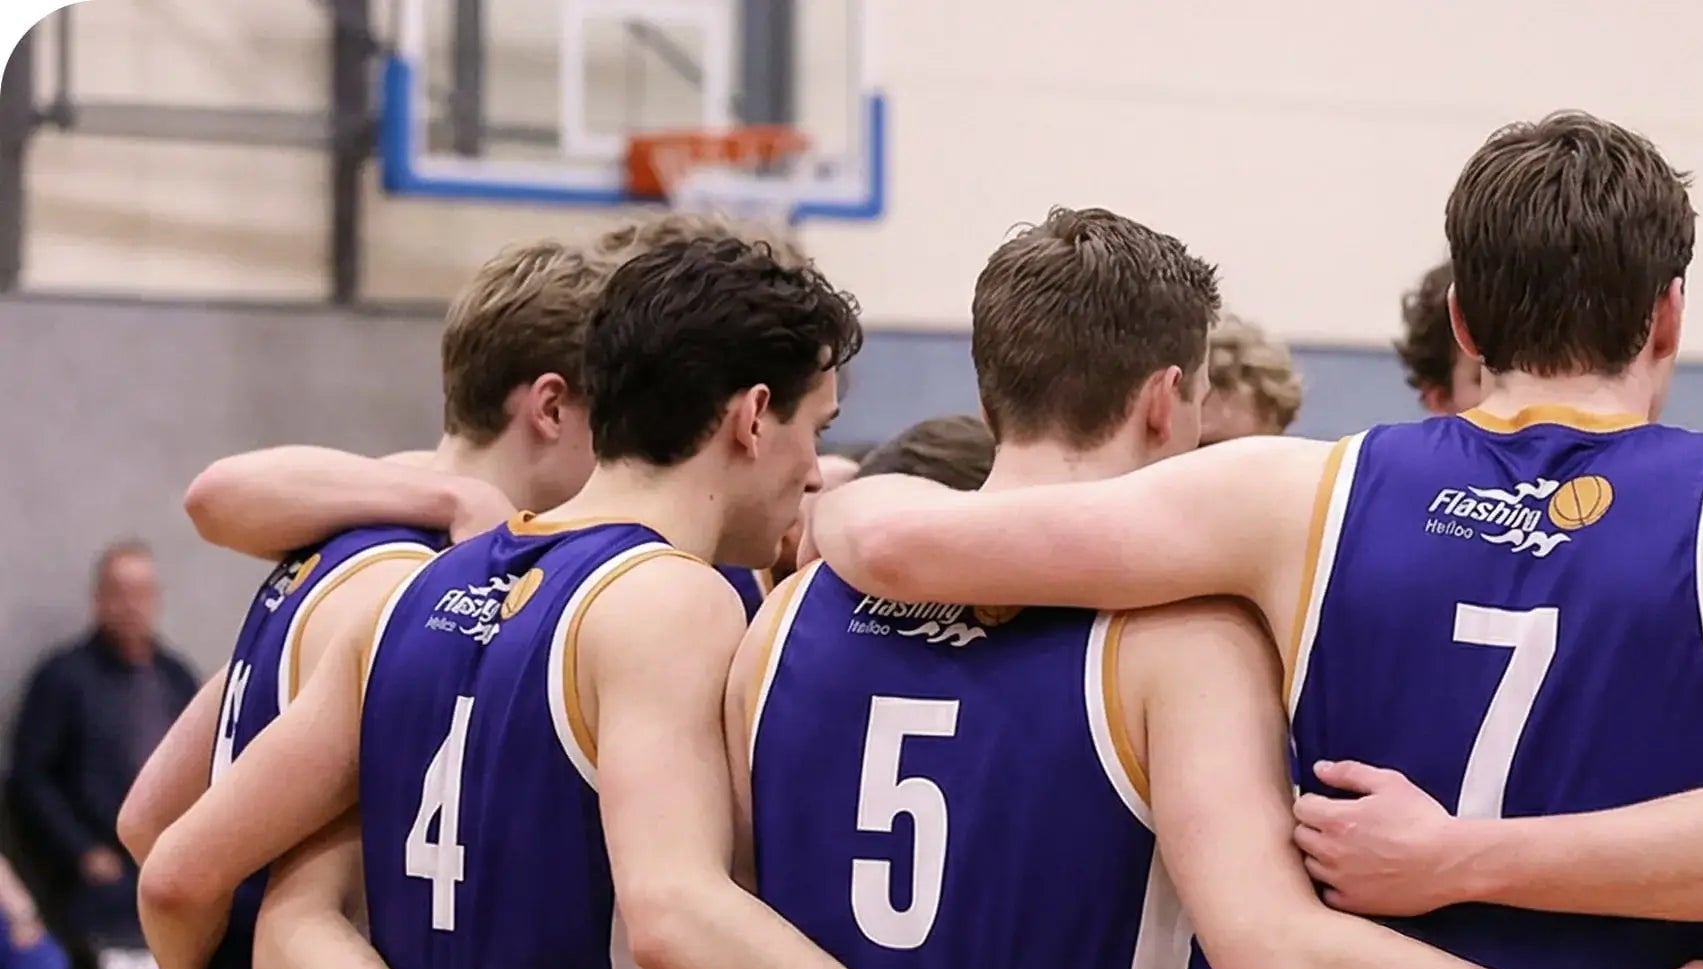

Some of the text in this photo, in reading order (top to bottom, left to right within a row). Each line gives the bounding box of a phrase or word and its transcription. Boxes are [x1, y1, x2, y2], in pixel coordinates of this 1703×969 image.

[406, 696, 474, 931] 4
[852, 695, 960, 949] 5
[1453, 602, 1559, 820] 7
